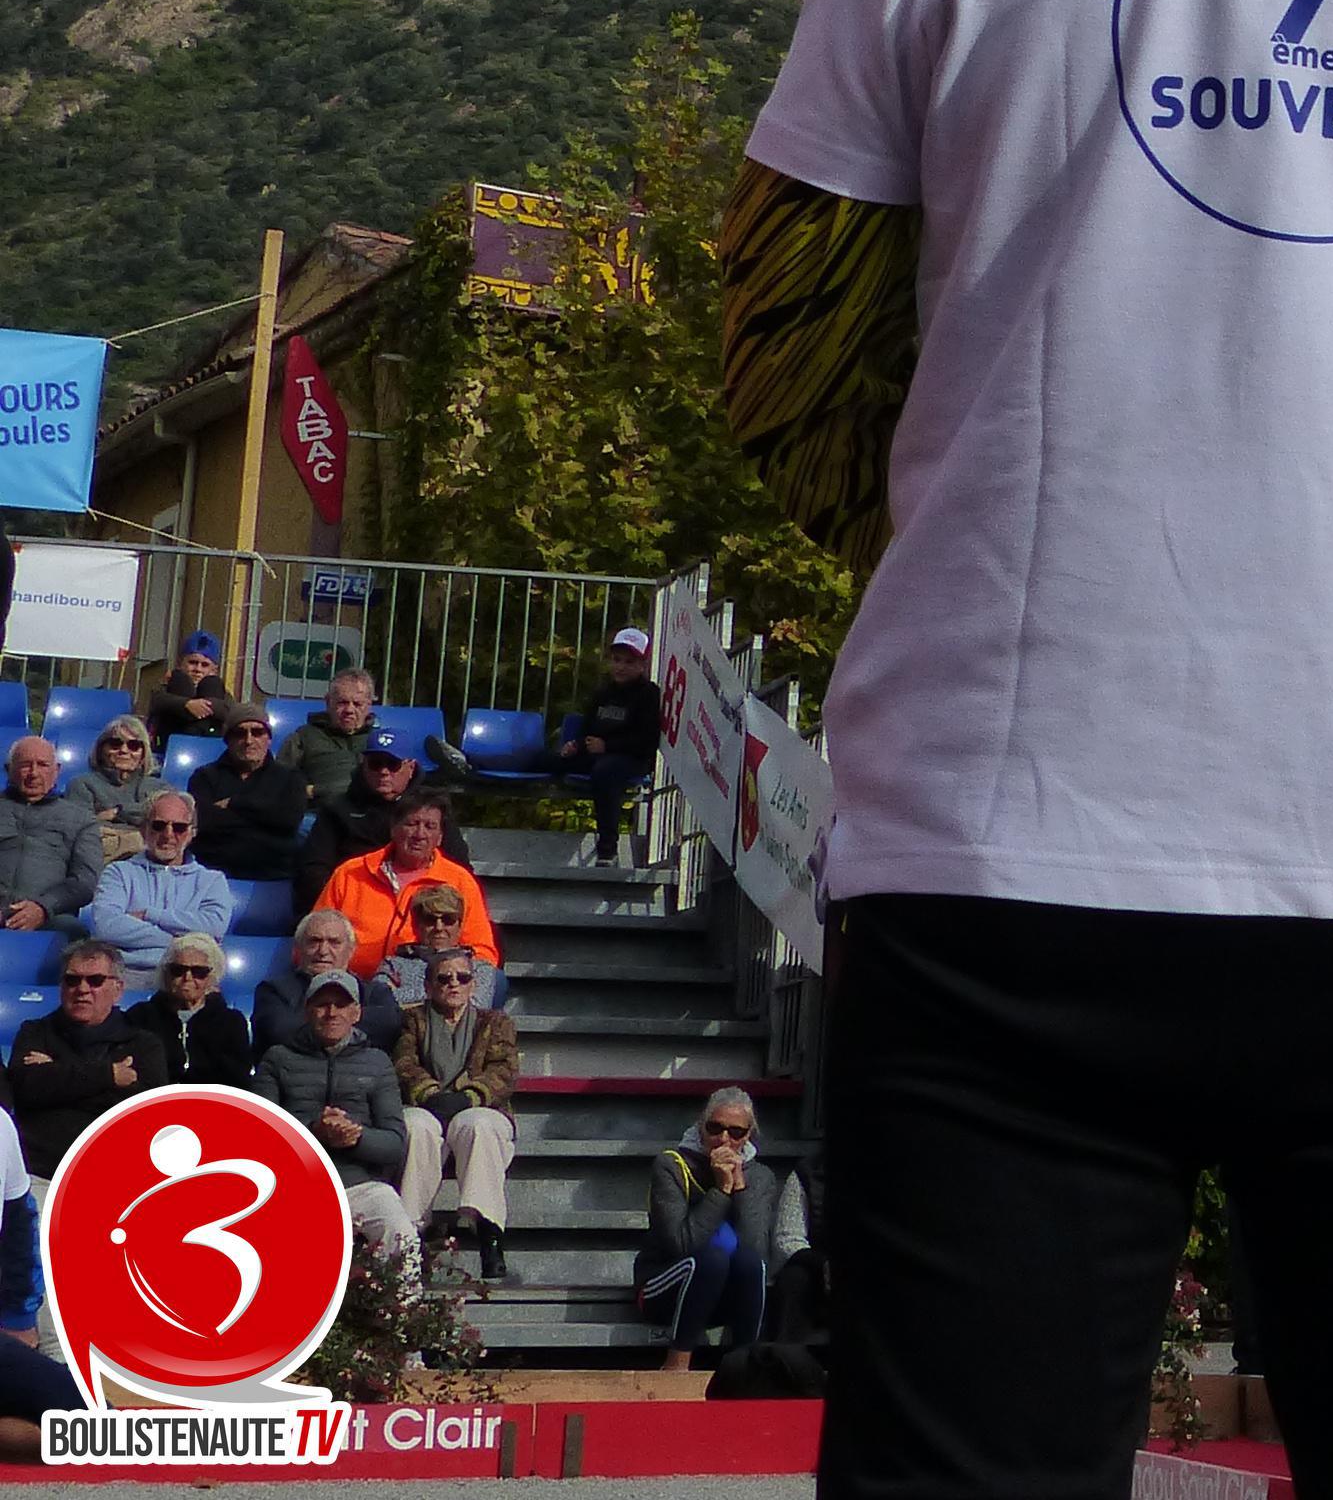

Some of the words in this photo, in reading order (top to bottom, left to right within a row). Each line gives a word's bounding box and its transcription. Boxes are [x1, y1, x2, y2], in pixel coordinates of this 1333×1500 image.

[0, 380, 81, 413] OURS
[295, 374, 337, 484] TABAC
[383, 1407, 502, 1450] Clair
